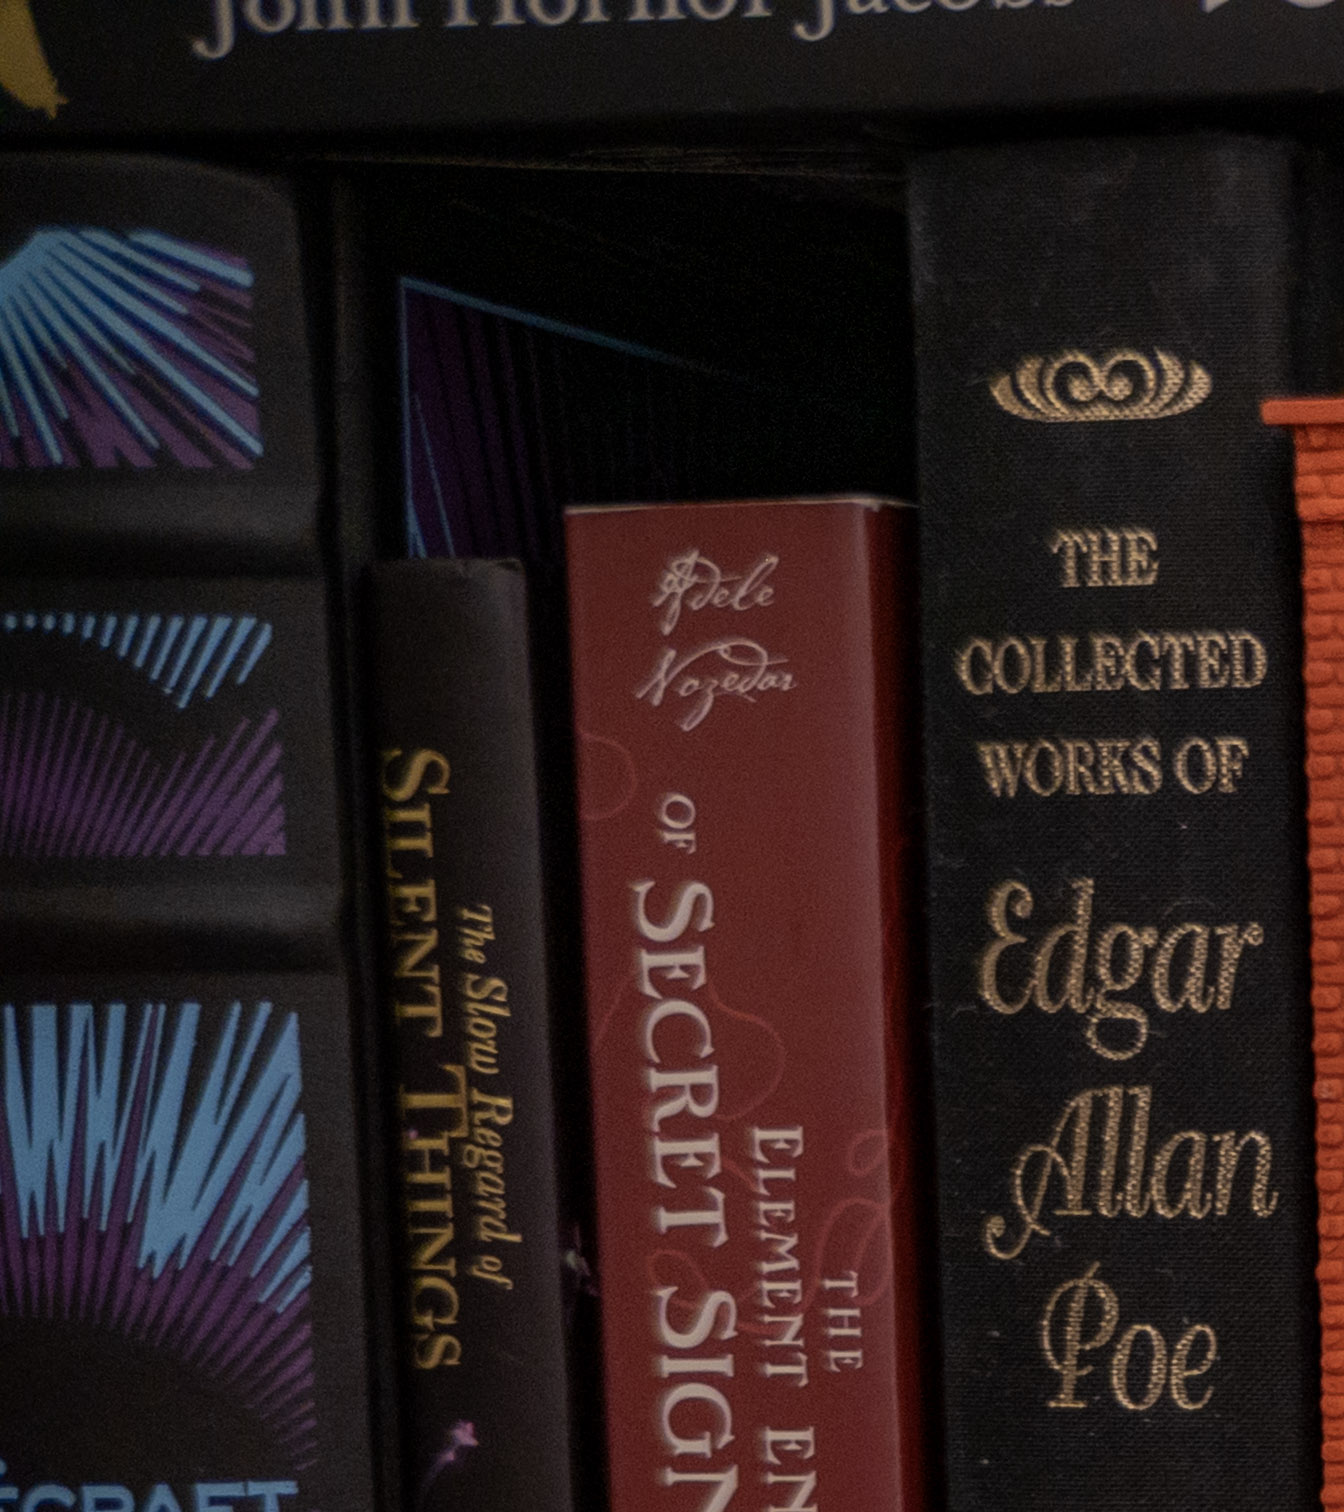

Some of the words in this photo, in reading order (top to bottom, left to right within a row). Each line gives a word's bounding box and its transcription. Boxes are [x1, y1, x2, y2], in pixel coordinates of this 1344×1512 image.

[1050, 527, 1159, 588] THE
[636, 637, 798, 733] Nozedar
[955, 628, 1269, 695] COLLECTED
[976, 736, 1164, 799] WORKS
[1172, 736, 1251, 795] OF
[659, 792, 698, 856] OF
[380, 747, 451, 1039] SILENT
[456, 904, 497, 967] The
[979, 877, 1265, 1061] Edgar
[461, 972, 512, 1075] Slow
[632, 880, 730, 1249] SECRET
[397, 1063, 470, 1371] THINGS
[461, 1087, 523, 1243] Regard
[982, 1084, 1280, 1260] Allan
[466, 1254, 514, 1291] of
[750, 1126, 809, 1387] ELEMENT
[823, 1270, 864, 1375] THE
[1040, 1260, 1218, 1411] Poe
